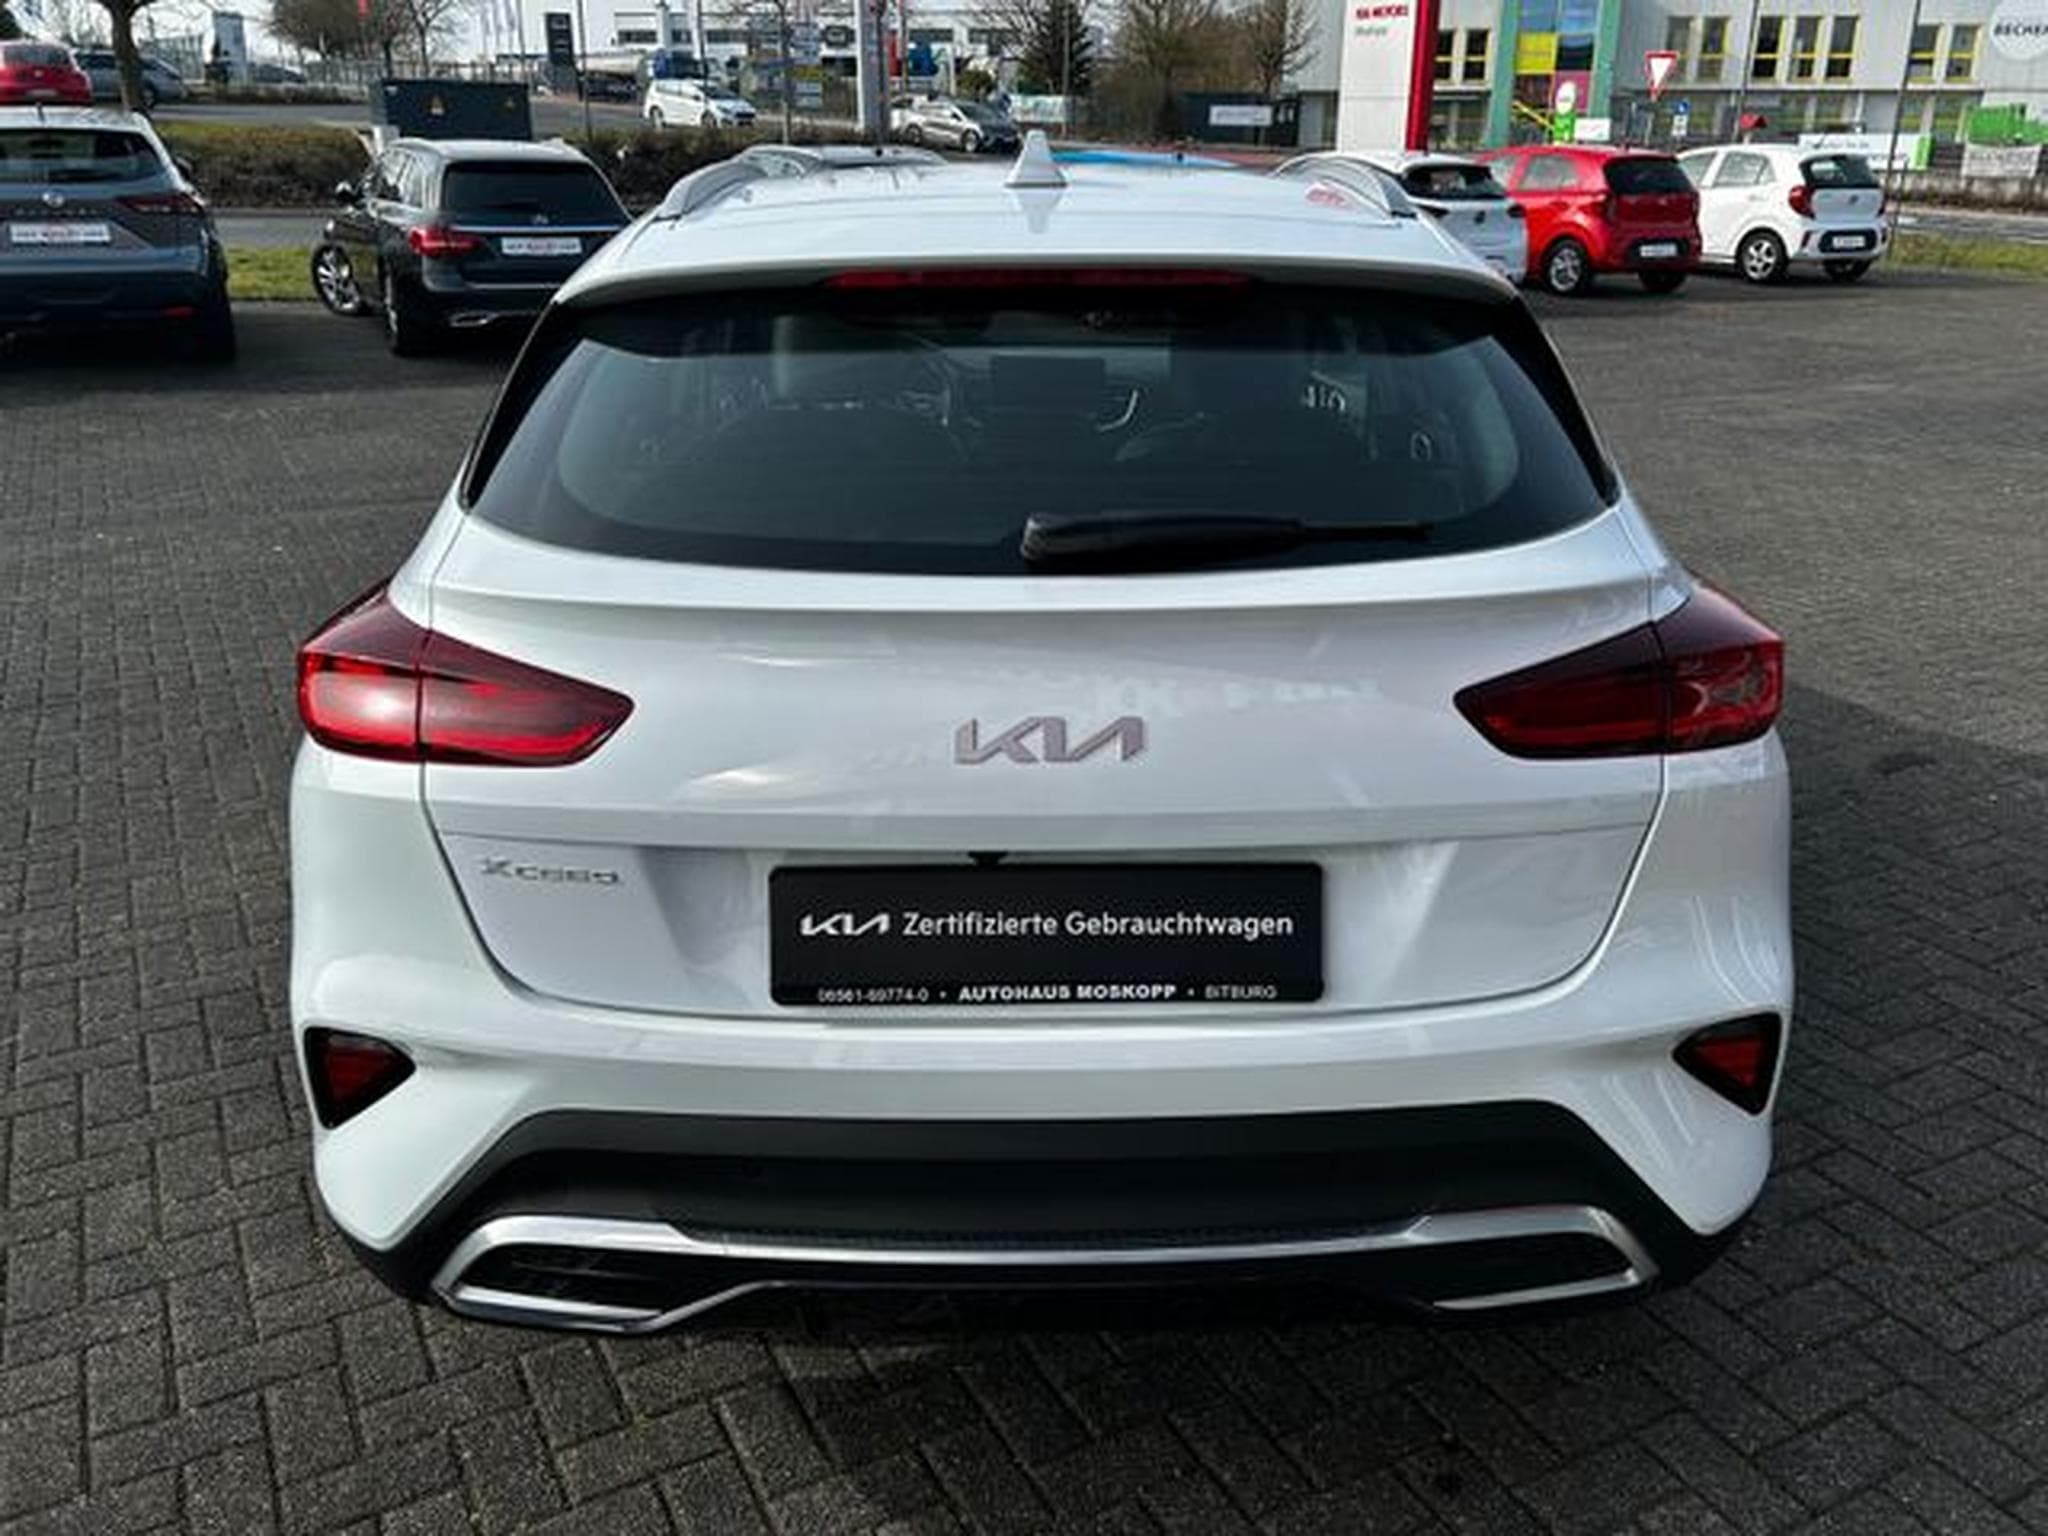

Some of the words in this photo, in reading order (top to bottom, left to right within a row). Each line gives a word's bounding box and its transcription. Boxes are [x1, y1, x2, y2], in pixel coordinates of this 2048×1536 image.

[954, 717, 1145, 765] KIA
[801, 913, 890, 936] KIA
[902, 911, 1058, 935] Zertifizierte
[1064, 911, 1294, 941] Gebrauchtwagen
[958, 985, 1071, 1001] AUTOHAUS
[1076, 984, 1177, 1000] MOSKOPP
[1204, 984, 1278, 1000] BITBURG
